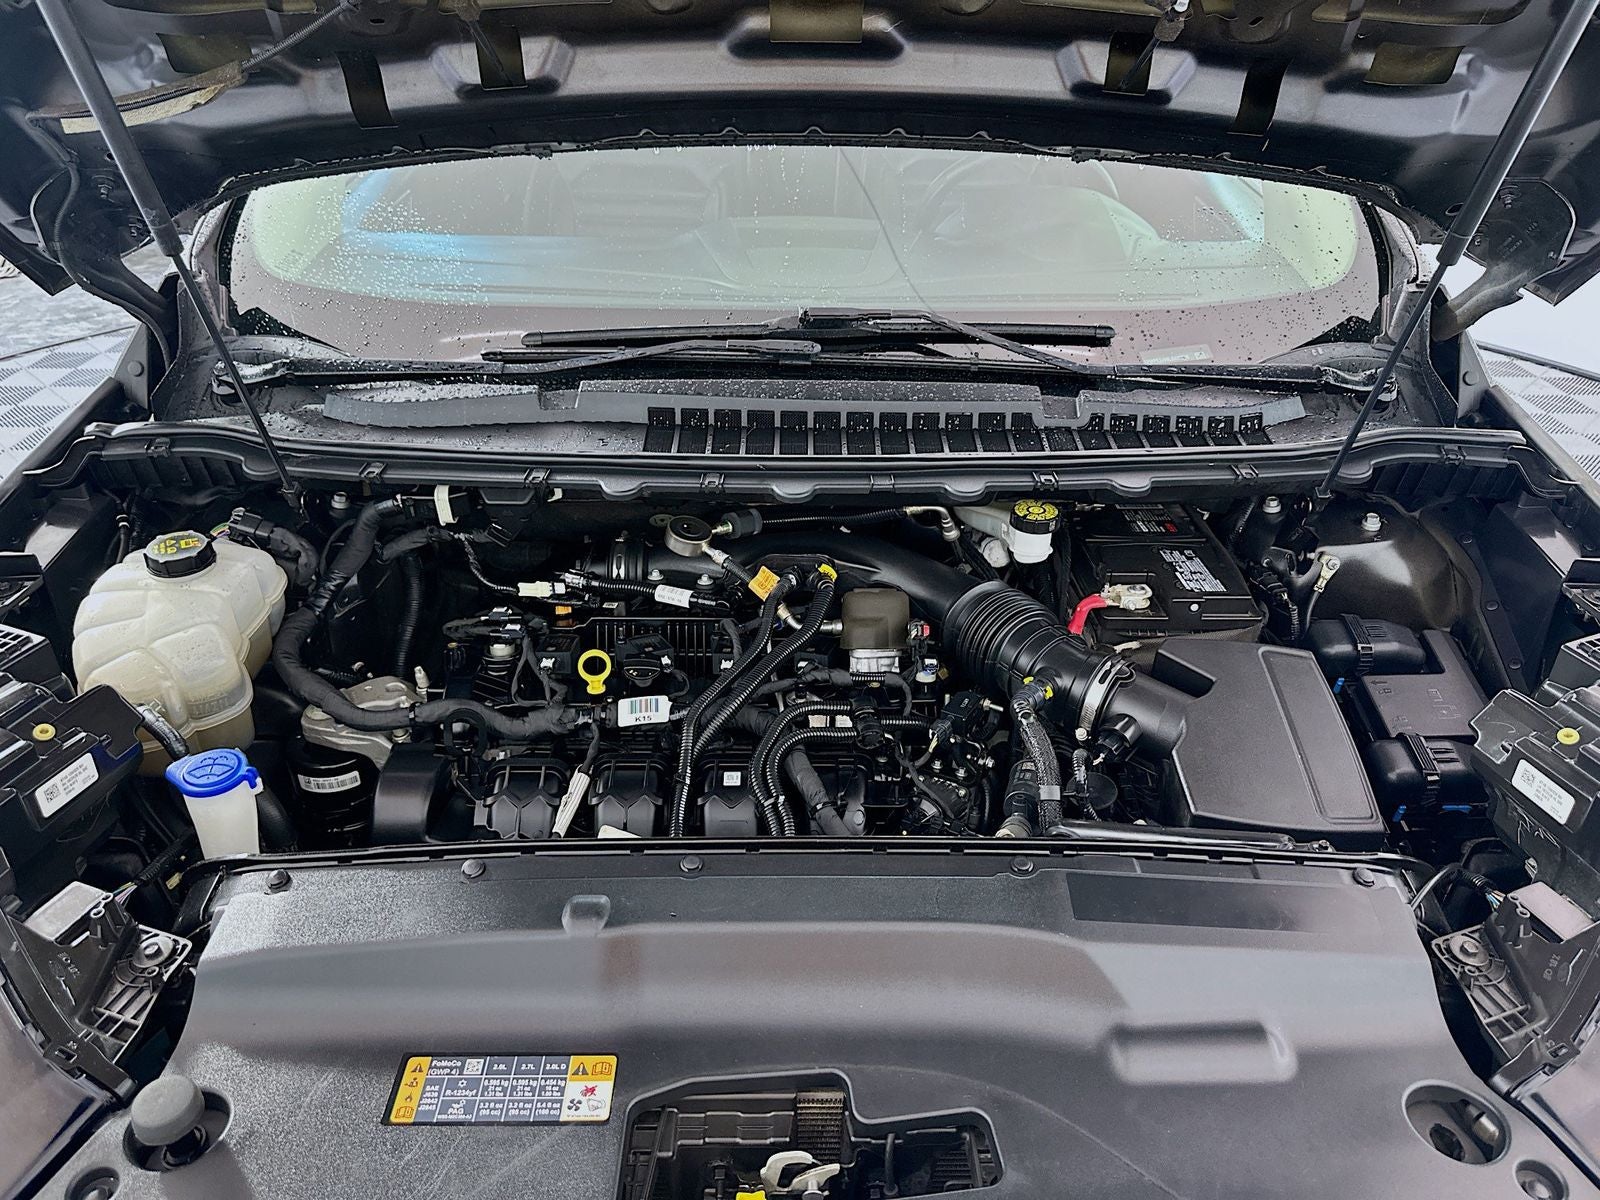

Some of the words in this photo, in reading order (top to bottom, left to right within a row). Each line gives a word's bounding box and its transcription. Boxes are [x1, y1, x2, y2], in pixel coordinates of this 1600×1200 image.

[431, 1059, 462, 1067] FoMoCo
[428, 1068, 451, 1077] (GWP
[451, 1068, 460, 1077] 4)
[445, 1089, 477, 1097] R-1234yf
